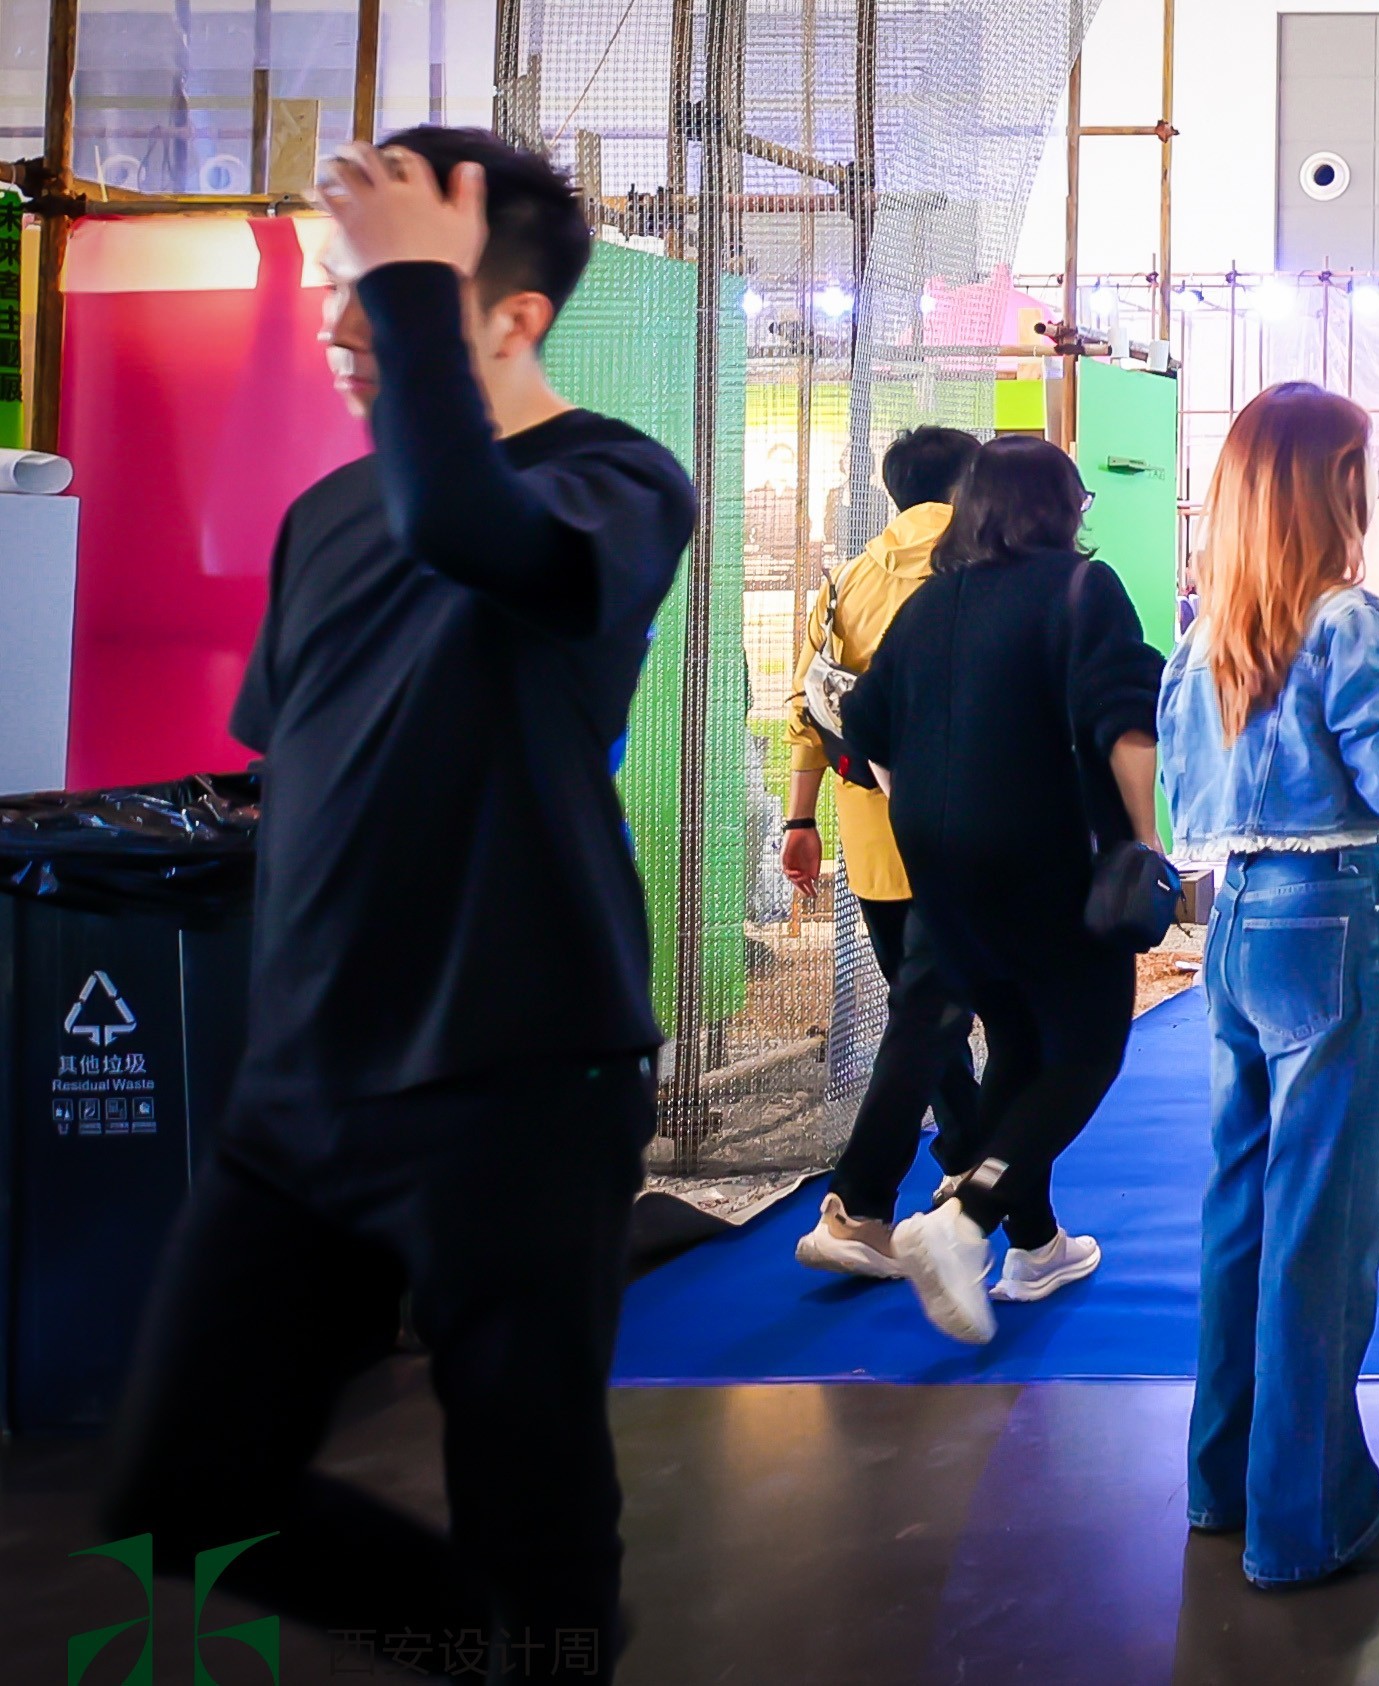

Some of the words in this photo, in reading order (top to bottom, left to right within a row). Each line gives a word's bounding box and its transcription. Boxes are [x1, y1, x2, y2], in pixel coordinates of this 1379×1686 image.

[58, 1053, 147, 1076] 其他垃圾
[52, 1079, 110, 1092] Residual
[112, 1078, 155, 1091] Waste
